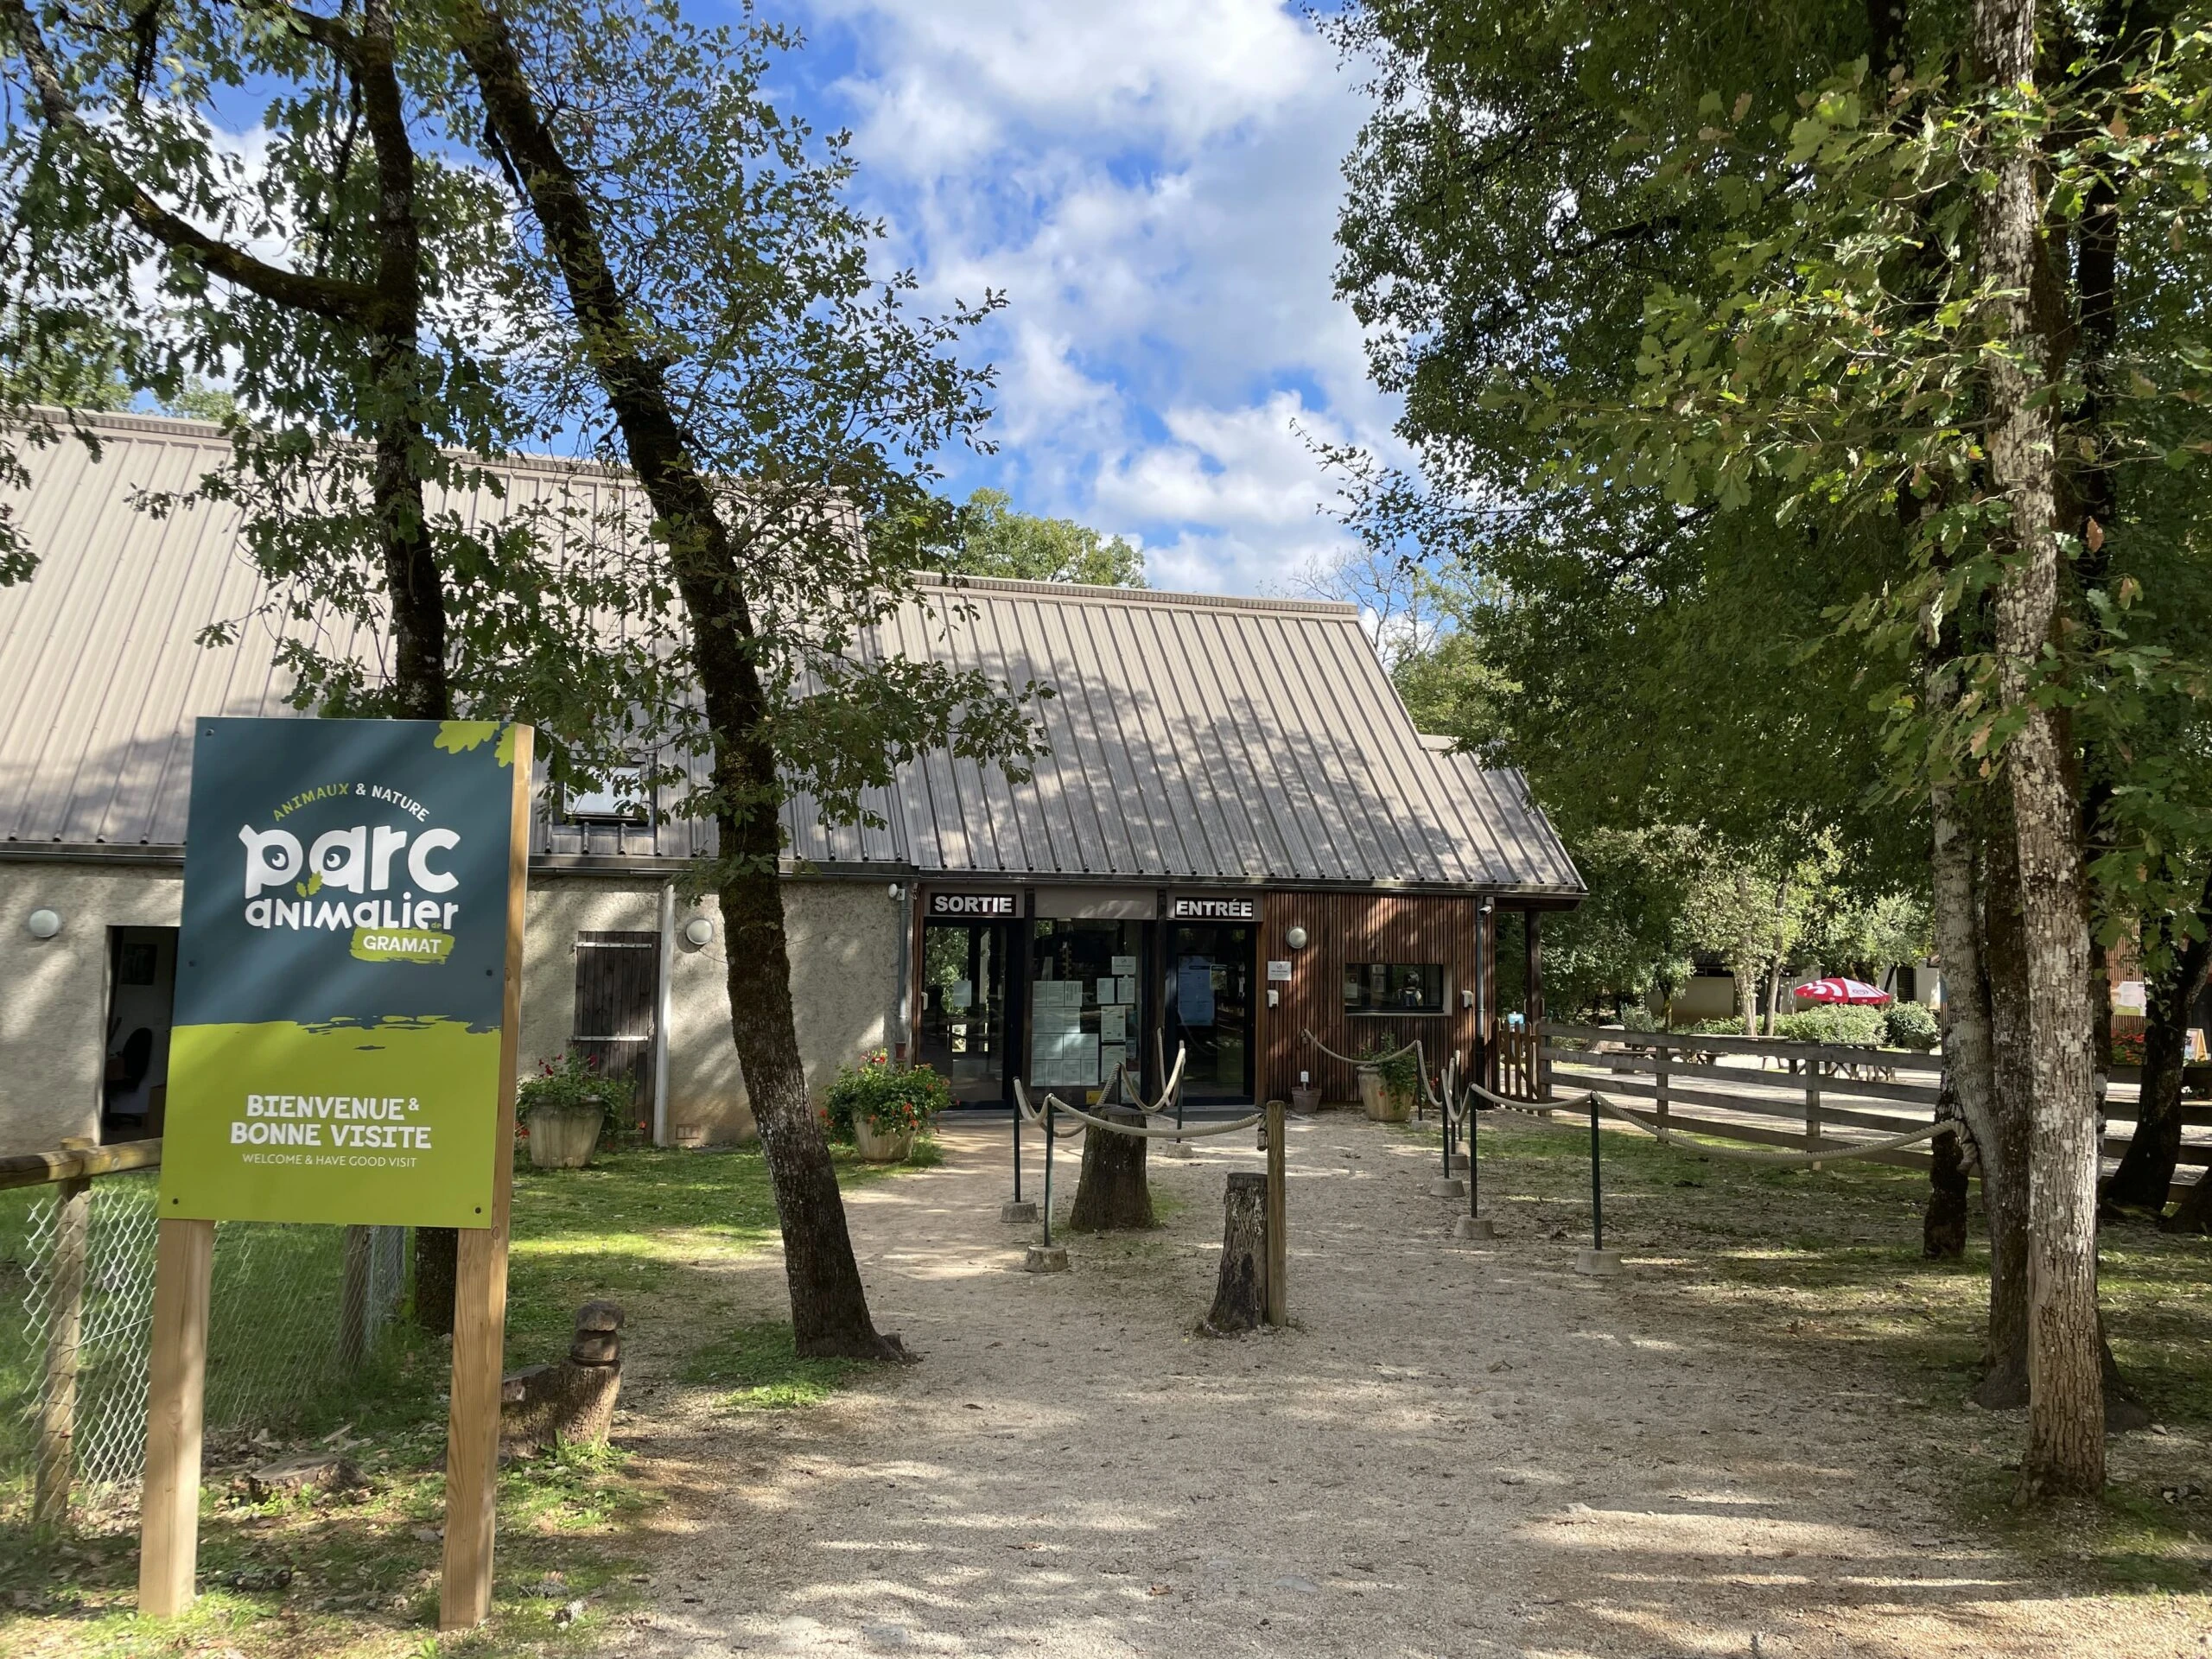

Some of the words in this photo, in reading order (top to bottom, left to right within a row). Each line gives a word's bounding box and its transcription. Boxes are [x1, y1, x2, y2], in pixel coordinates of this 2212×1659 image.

[273, 783, 349, 822] ANIMAUX
[355, 783, 366, 796] &
[372, 785, 430, 823] NATURE
[238, 825, 461, 898] parc
[934, 895, 1013, 913] SORTIE
[1176, 898, 1253, 918] ENTRÉE
[363, 935, 442, 954] GRAMAT
[246, 1094, 405, 1121] BIENVENUE
[408, 1097, 420, 1111] &
[231, 1122, 321, 1146] BONNE
[330, 1124, 432, 1149] VISITE
[242, 1154, 302, 1165] WELCOME
[305, 1154, 313, 1165] &
[315, 1155, 346, 1166] HAVE
[348, 1155, 386, 1166] GOOD
[389, 1157, 417, 1167] VISIT
